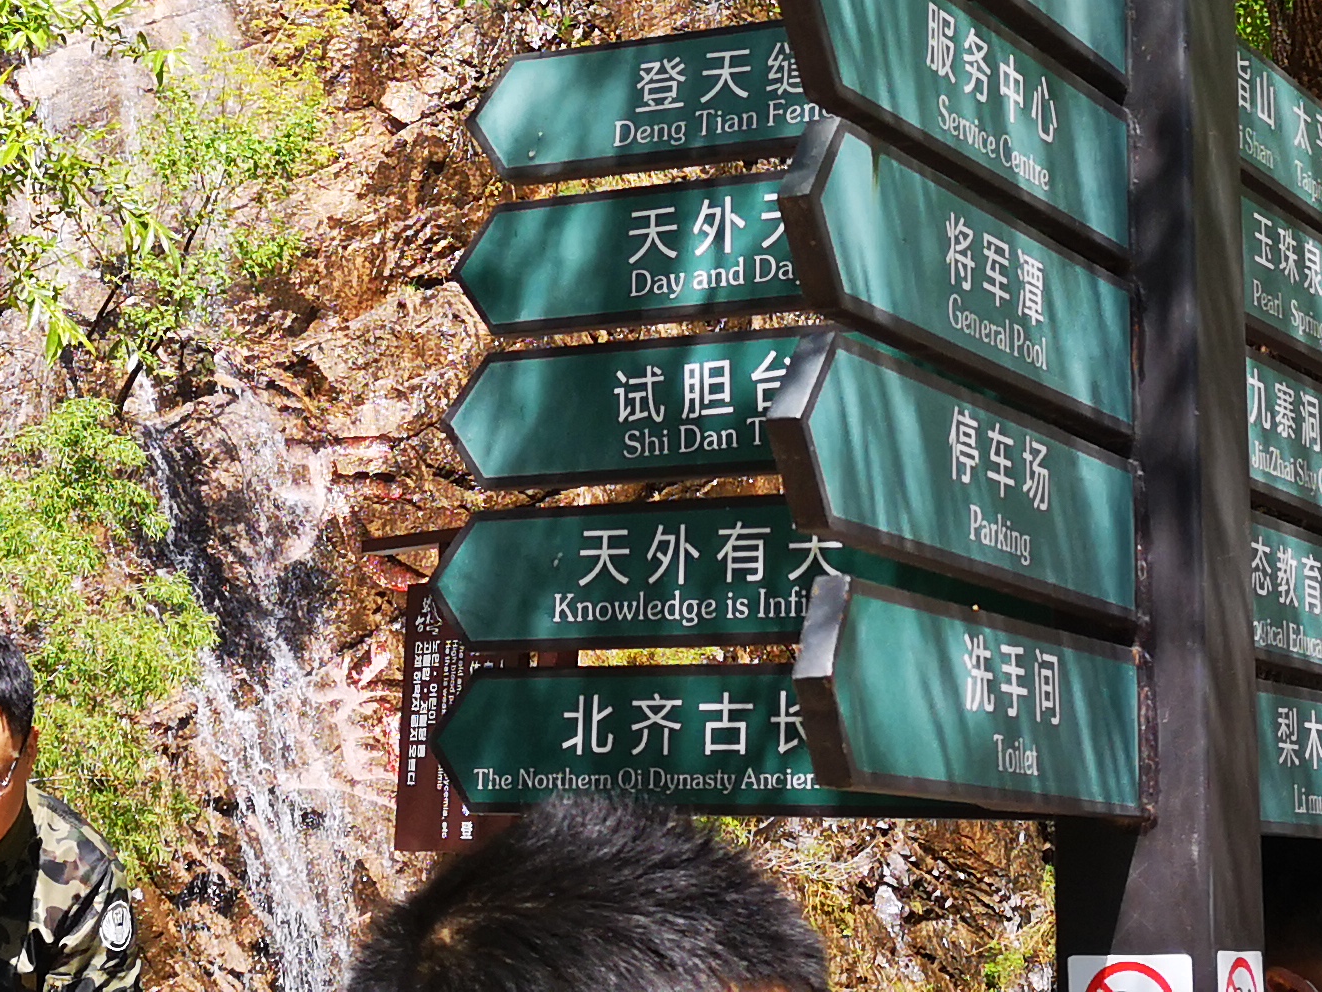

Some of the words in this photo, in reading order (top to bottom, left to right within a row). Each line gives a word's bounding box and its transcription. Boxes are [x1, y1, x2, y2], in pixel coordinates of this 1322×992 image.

[635, 42, 803, 113] 登天缝
[926, 1, 1057, 142] 服务中心
[614, 119, 686, 148] Deng
[695, 110, 757, 136] Tian
[767, 99, 838, 126] Fen
[939, 95, 996, 158] Service
[1000, 135, 1049, 190] Centre
[1245, 127, 1274, 169] Shan
[630, 268, 684, 298] Day
[692, 256, 745, 289] and
[754, 254, 800, 285] Da
[945, 211, 1044, 326] 将军潭
[1253, 212, 1322, 296] 玉珠泉
[1252, 279, 1282, 318] Pearl
[948, 293, 1010, 354] General
[1013, 323, 1048, 371] Pool
[614, 350, 791, 424] 试胆台
[623, 426, 668, 459] Shi
[679, 424, 738, 454] Dan
[948, 406, 1049, 511] 停车场
[1252, 440, 1295, 482] JiuZhai
[1296, 458, 1317, 495] Sky
[969, 504, 1031, 565] Parking
[553, 590, 716, 624] Knowledge
[726, 590, 749, 619] is
[963, 632, 1060, 726] 洗手间
[562, 690, 807, 756] 北齐古长
[474, 768, 512, 790] The
[518, 767, 611, 790] Northern
[618, 767, 642, 792] Qi
[648, 768, 735, 794] Dynasty
[993, 734, 1039, 777] Toilet
[1294, 784, 1307, 815] Li
